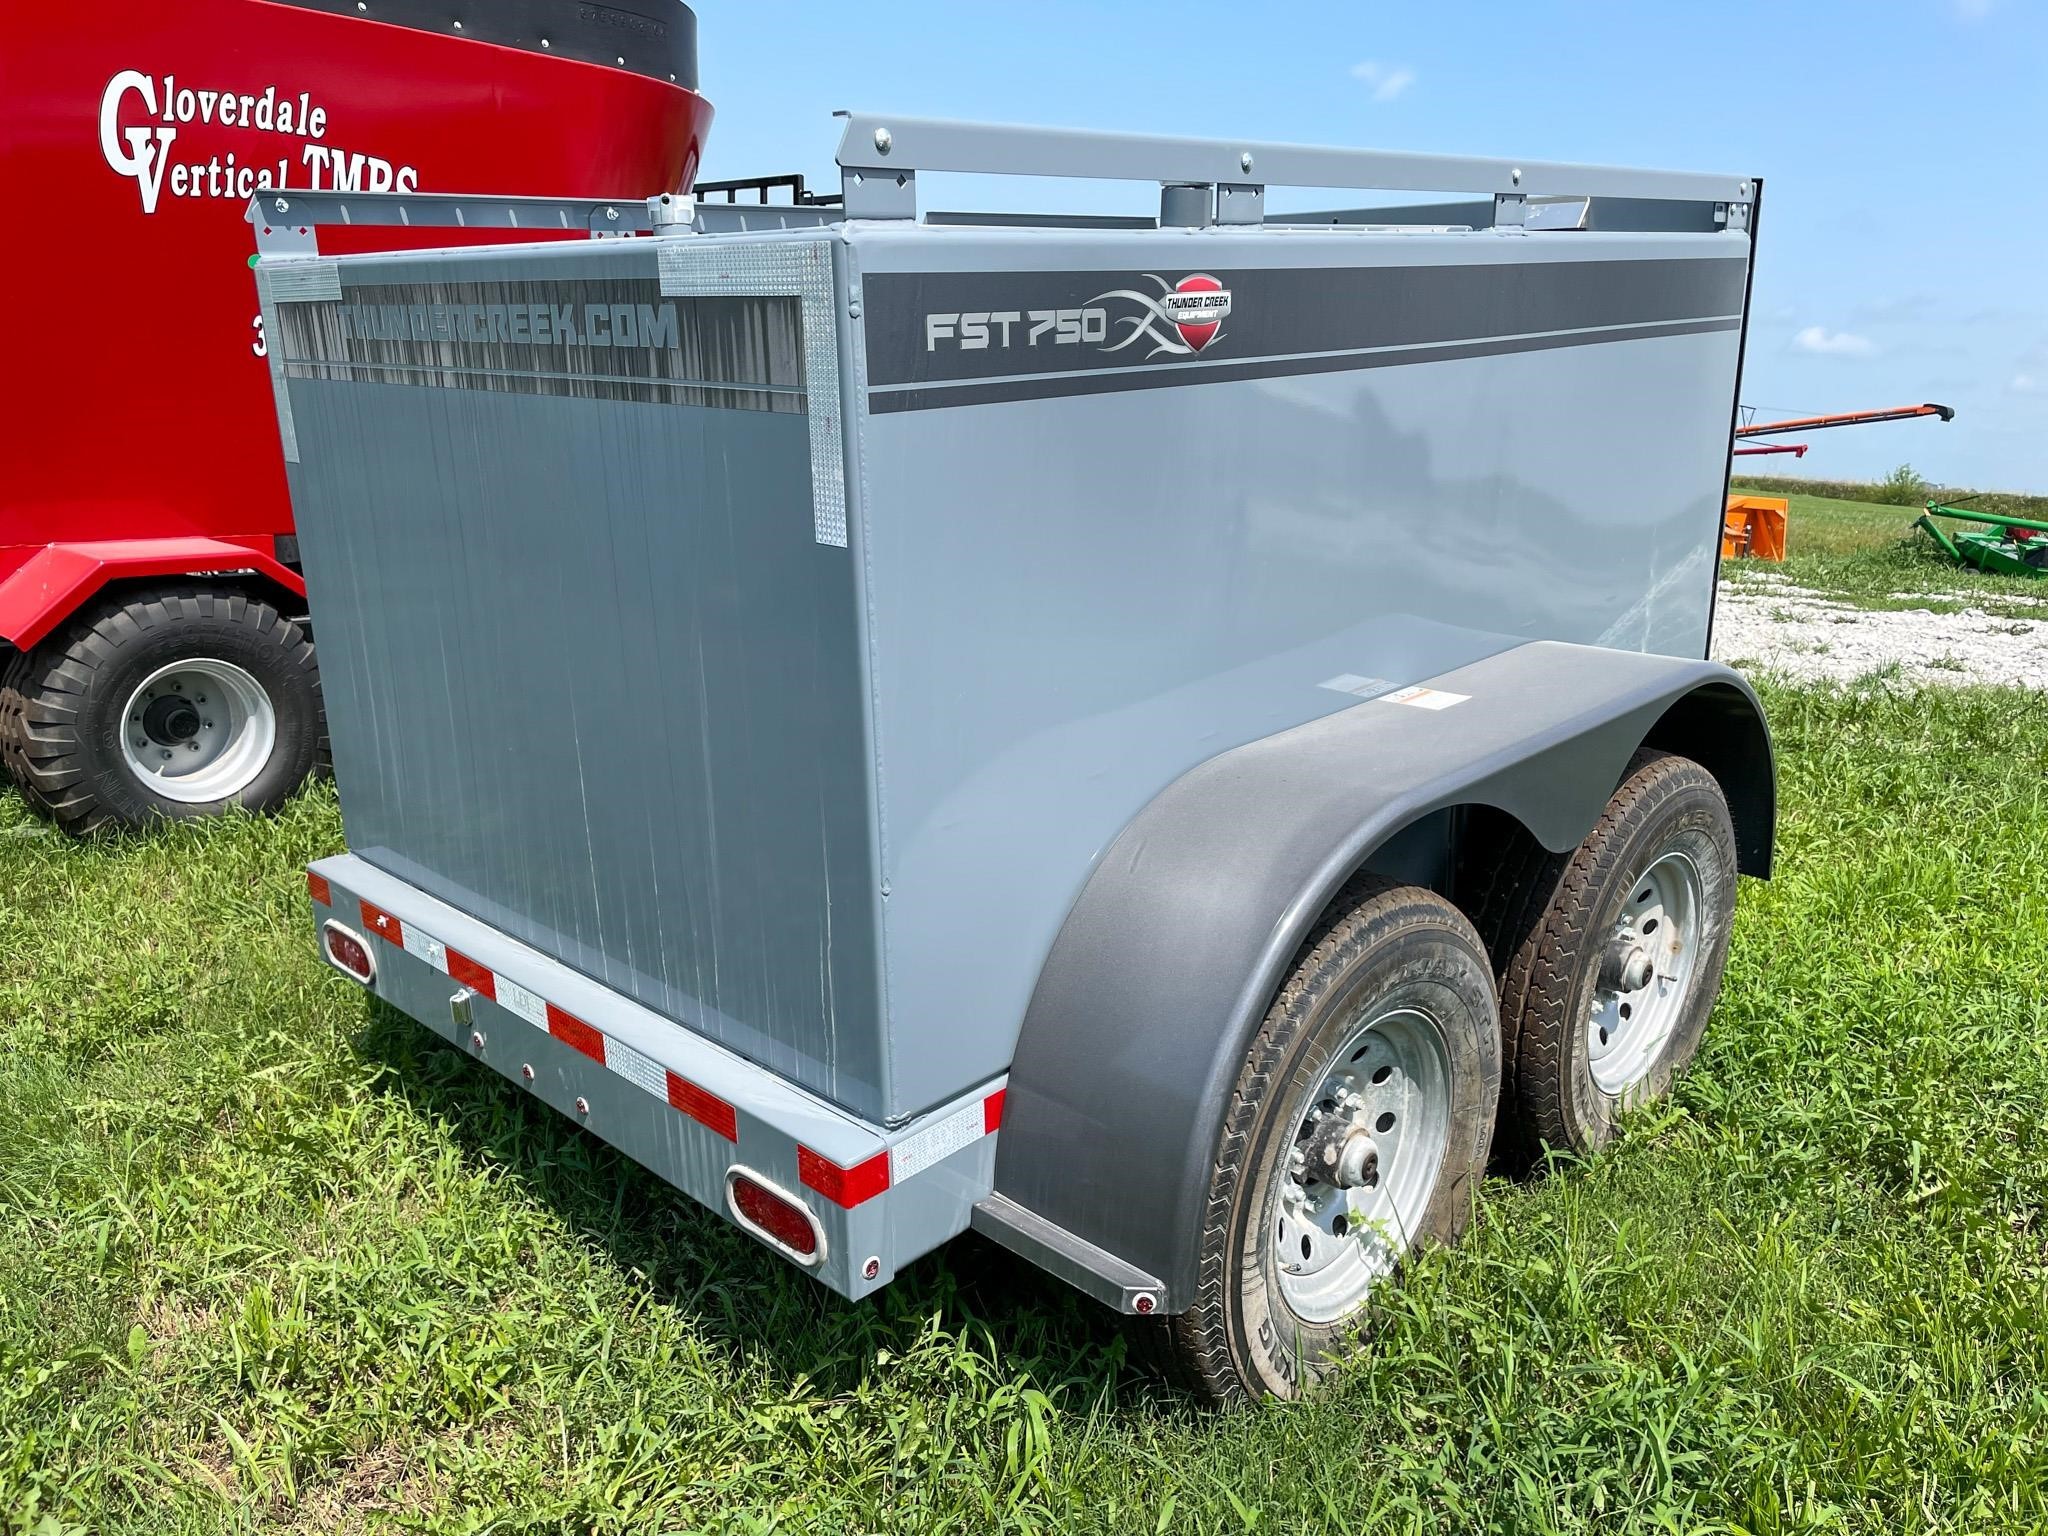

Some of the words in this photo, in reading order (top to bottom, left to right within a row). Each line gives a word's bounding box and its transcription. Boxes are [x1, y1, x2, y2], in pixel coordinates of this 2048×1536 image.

[98, 69, 327, 177] Cloverdale
[124, 126, 288, 214] Vertical
[337, 302, 679, 349] THUNDERCREEK.COM
[1167, 296, 1203, 309] THUNDER
[1204, 295, 1229, 308] CREEK
[926, 310, 1021, 351] FST
[1027, 307, 1107, 347] 750
